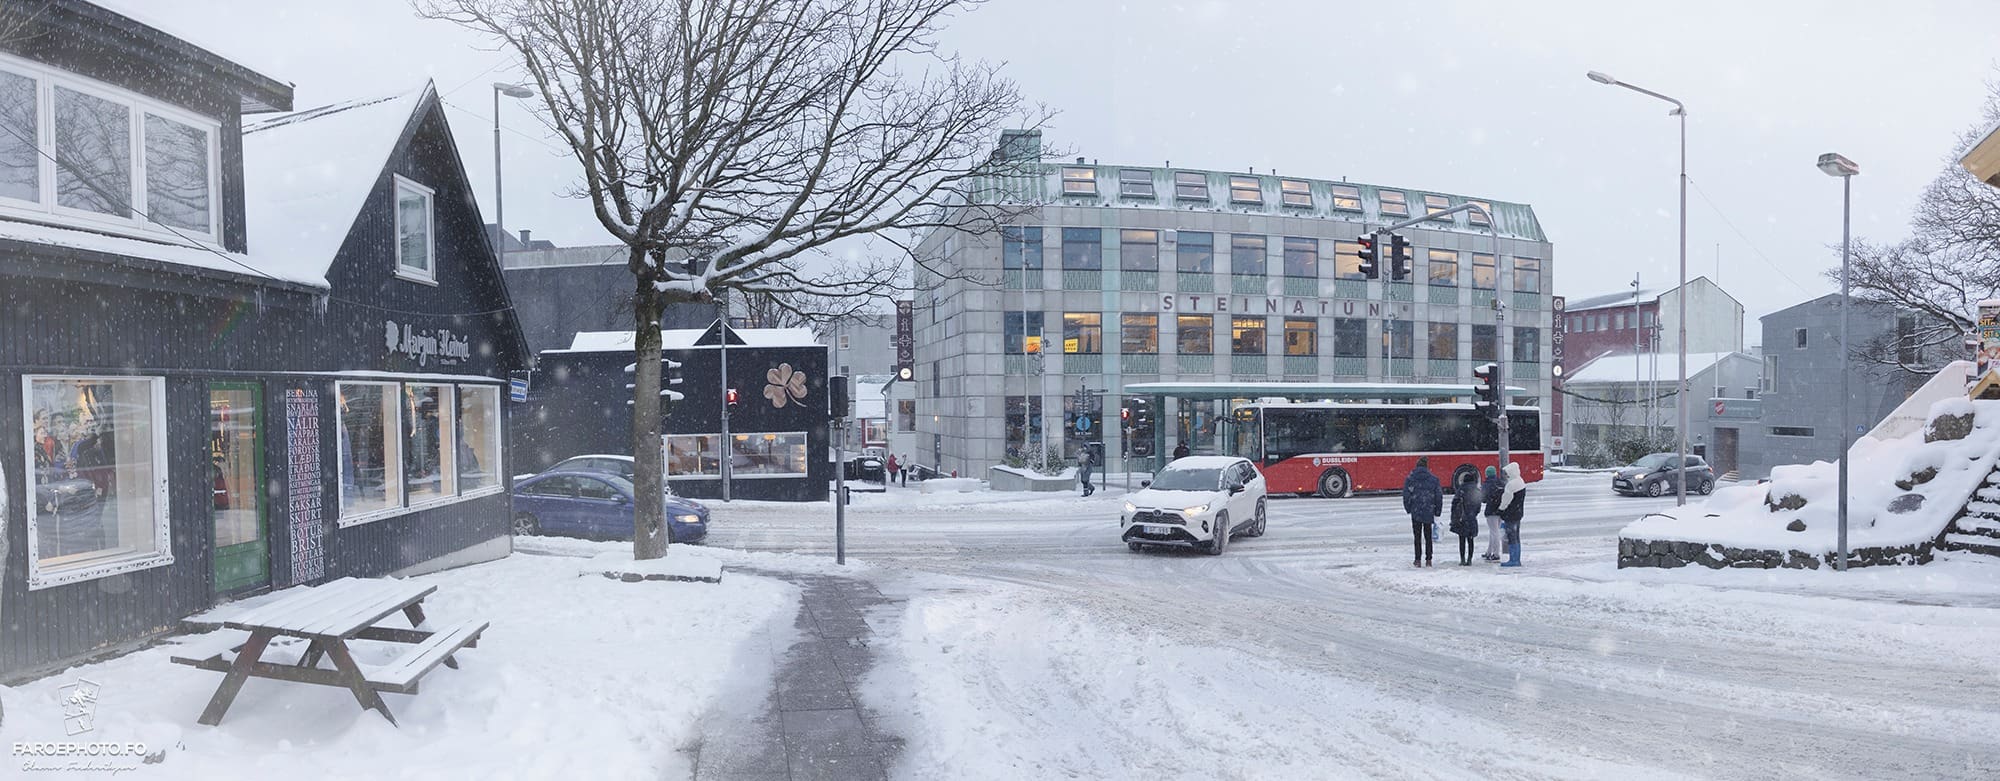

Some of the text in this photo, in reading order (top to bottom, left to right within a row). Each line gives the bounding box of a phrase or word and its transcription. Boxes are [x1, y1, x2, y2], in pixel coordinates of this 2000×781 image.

[1163, 295, 1379, 317] STEINATÚN
[286, 389, 318, 398] BERNINA
[287, 416, 320, 430] NÁLIR
[290, 497, 322, 512] SAKSAR
[291, 534, 322, 554] BRIST
